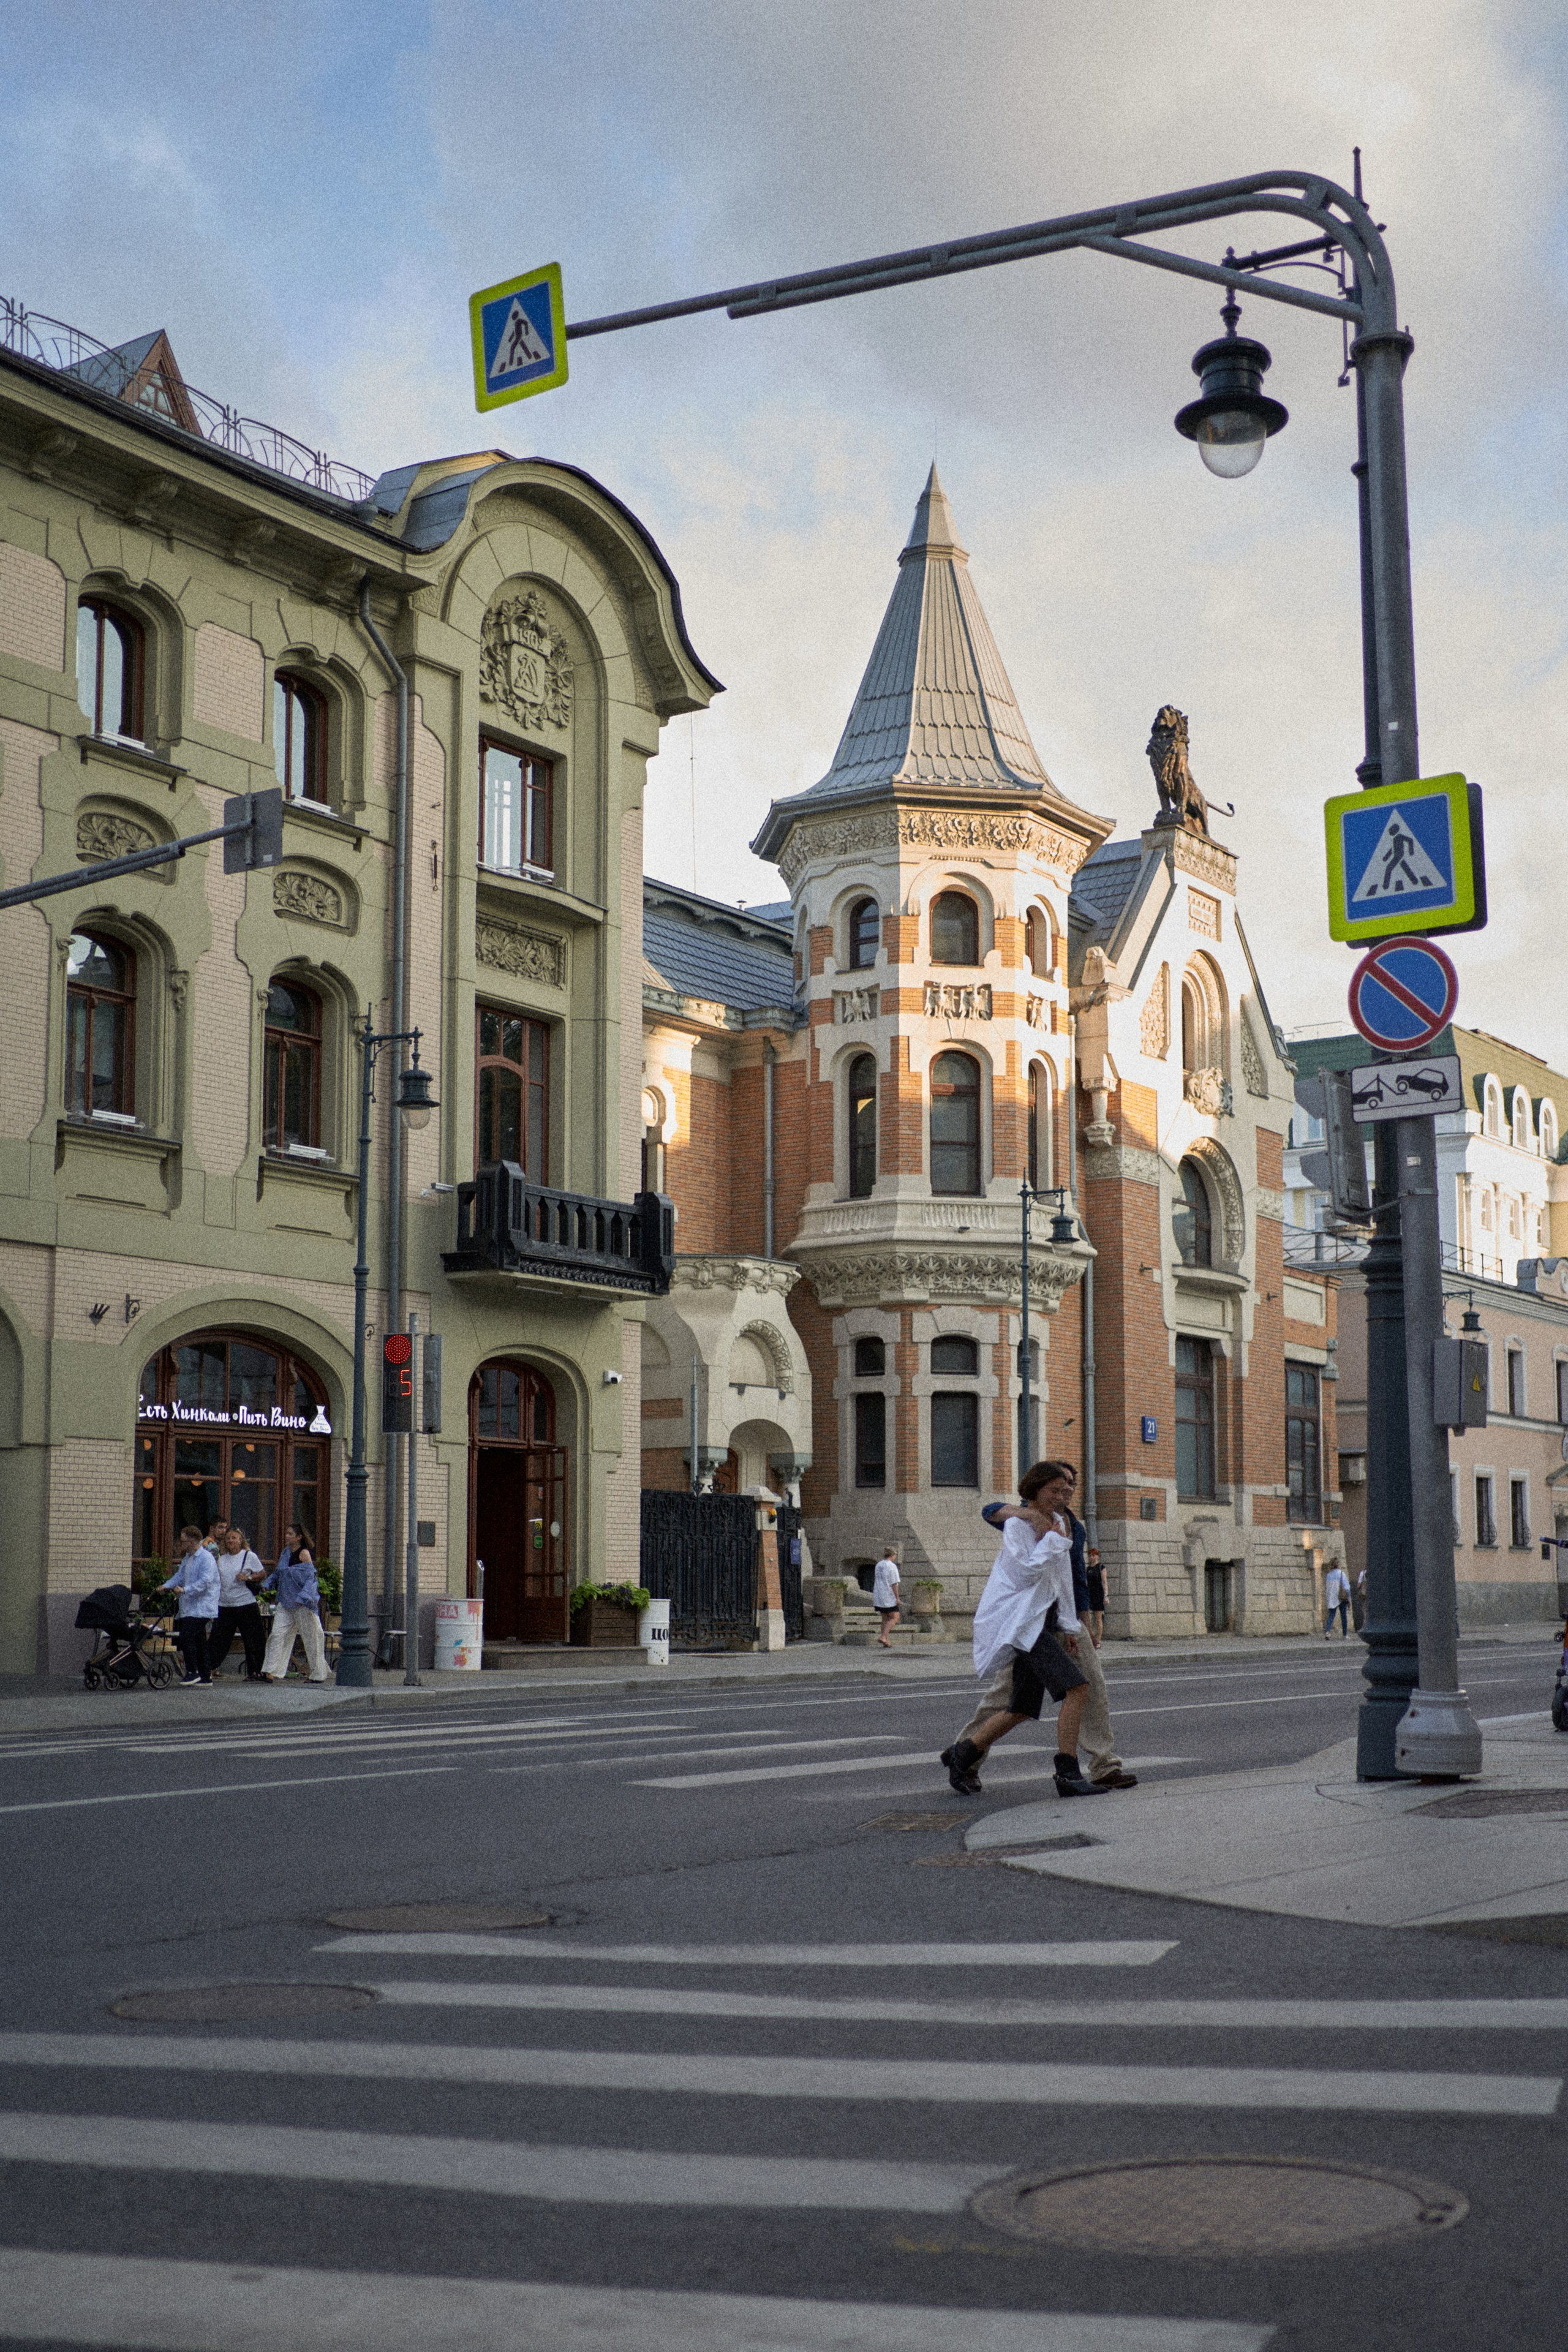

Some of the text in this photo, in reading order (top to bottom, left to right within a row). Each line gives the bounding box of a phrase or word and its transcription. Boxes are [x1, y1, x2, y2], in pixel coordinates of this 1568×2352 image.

[401, 1369, 411, 1395] 5
[172, 1399, 230, 1422] Хинкали
[239, 1405, 268, 1427] Пить
[271, 1406, 307, 1429] Вино
[1147, 1421, 1155, 1433] 21
